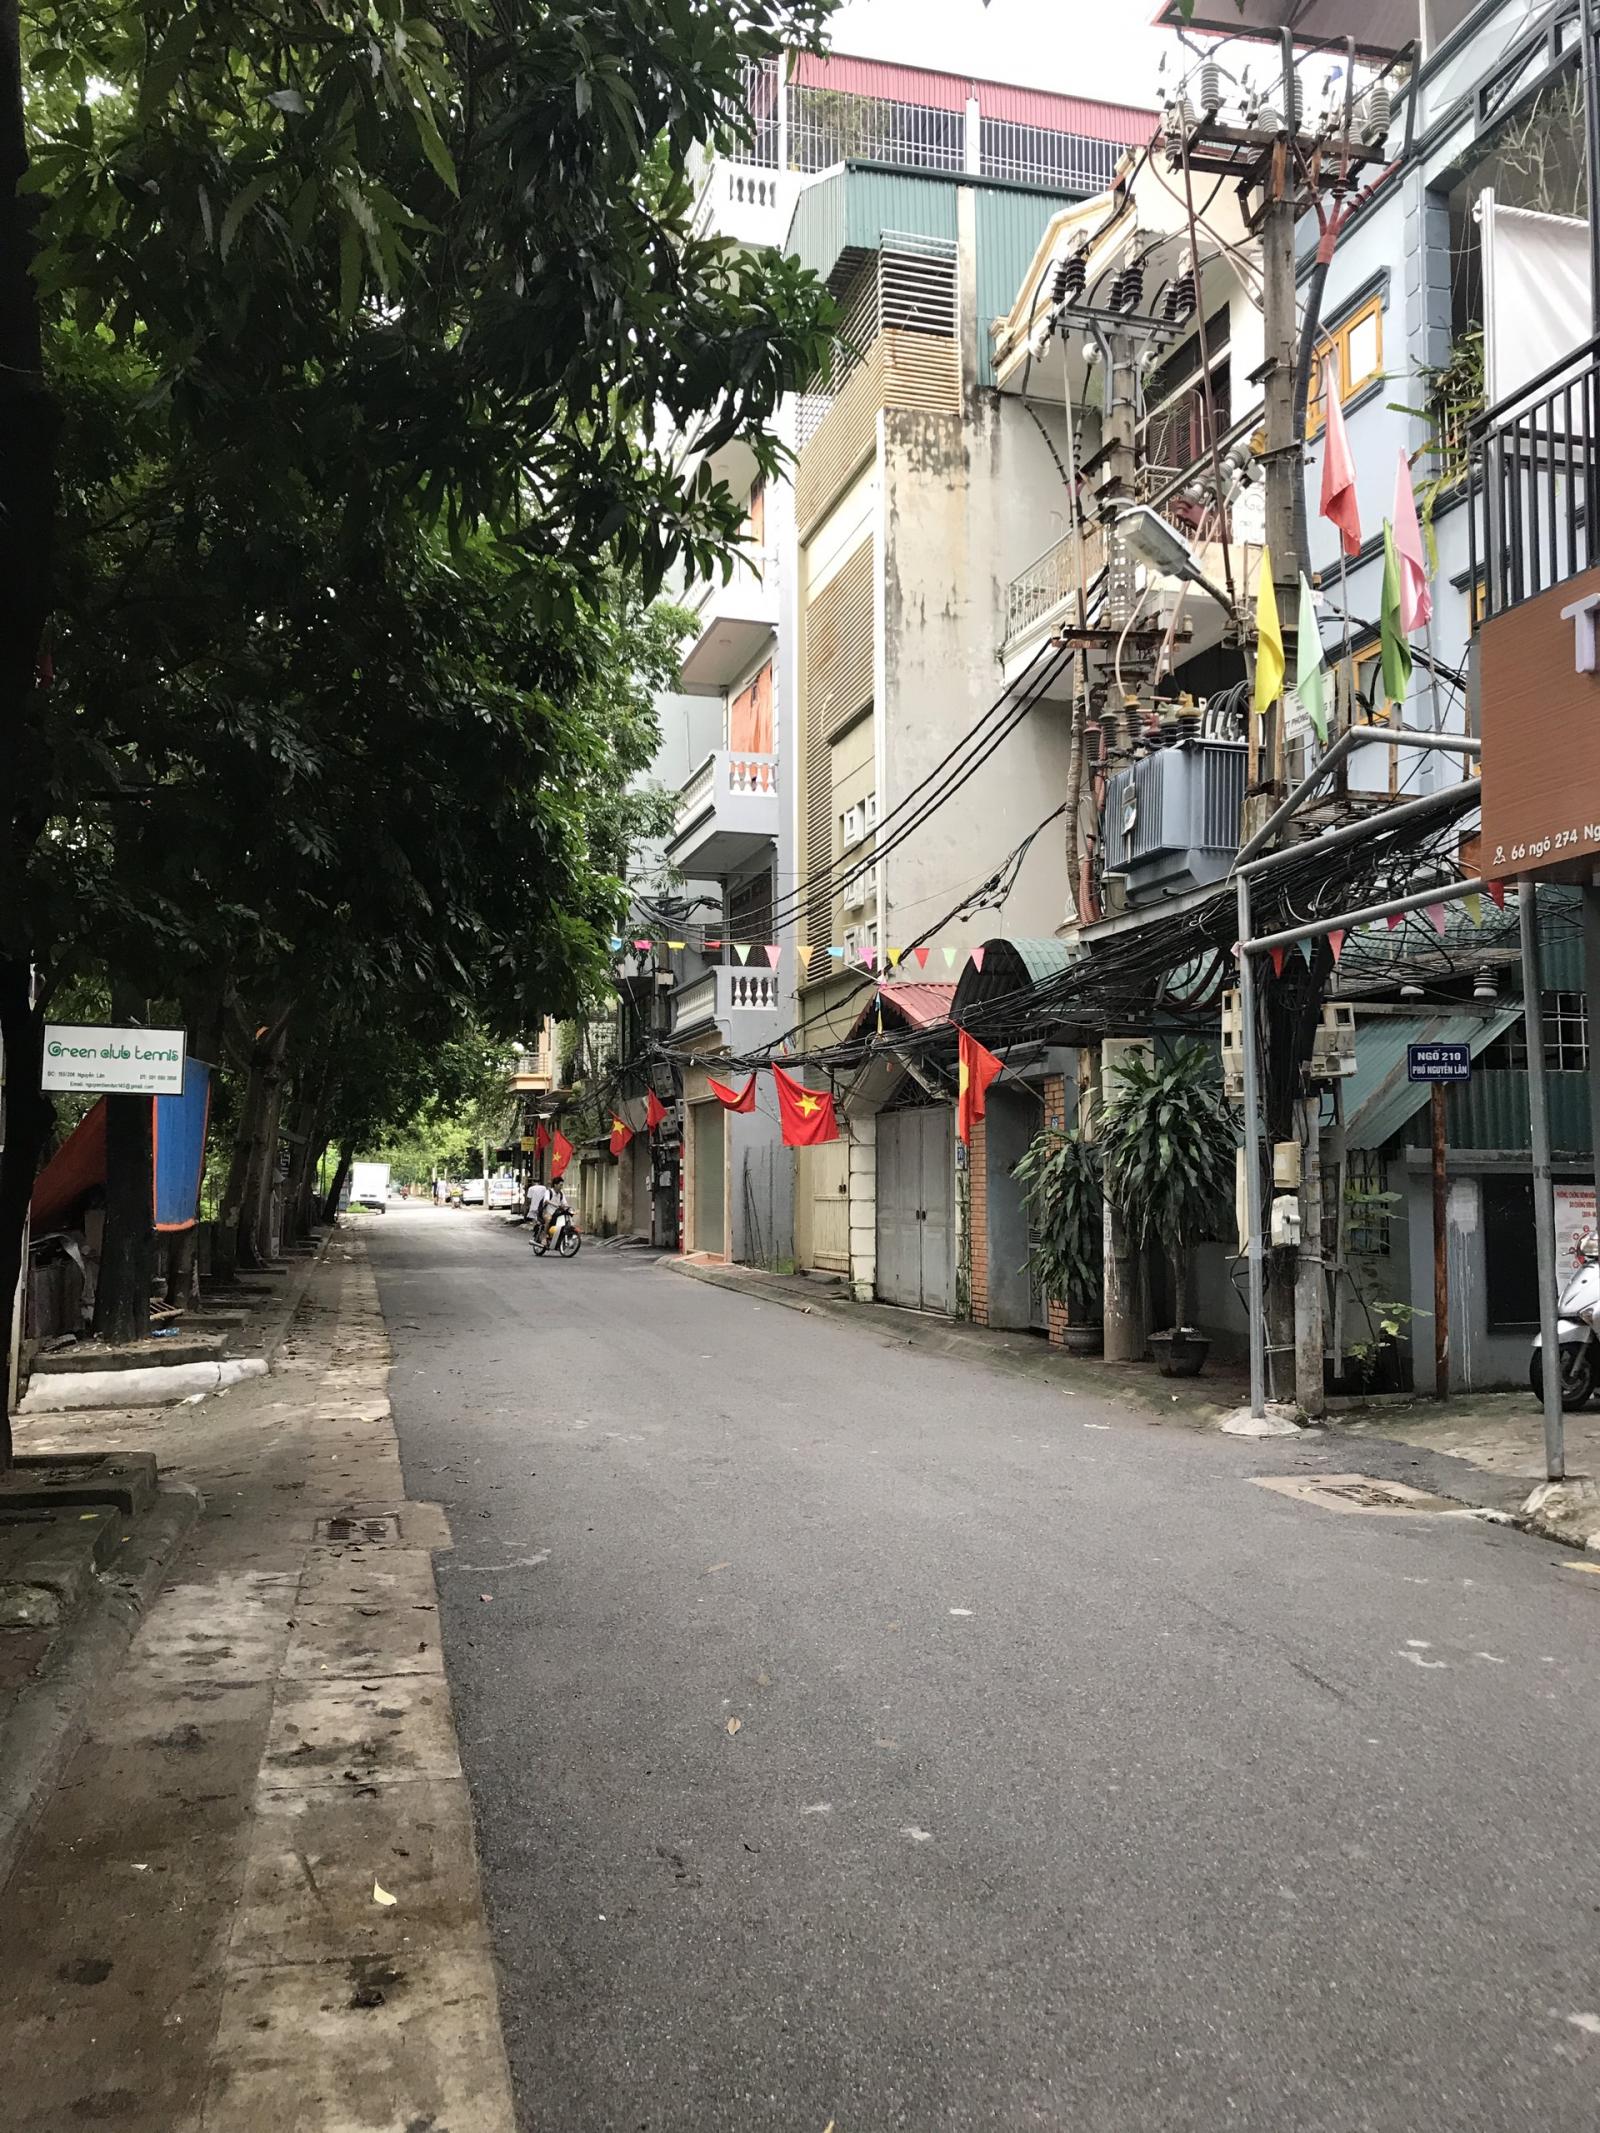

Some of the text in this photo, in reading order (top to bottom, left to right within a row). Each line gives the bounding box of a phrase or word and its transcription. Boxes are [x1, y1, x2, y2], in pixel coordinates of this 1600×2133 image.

[1511, 844, 1525, 860] 66
[1529, 836, 1551, 857] ngõ
[1555, 829, 1578, 849] 274
[47, 1041, 97, 1058] Green
[1441, 1052, 1461, 1061] 210
